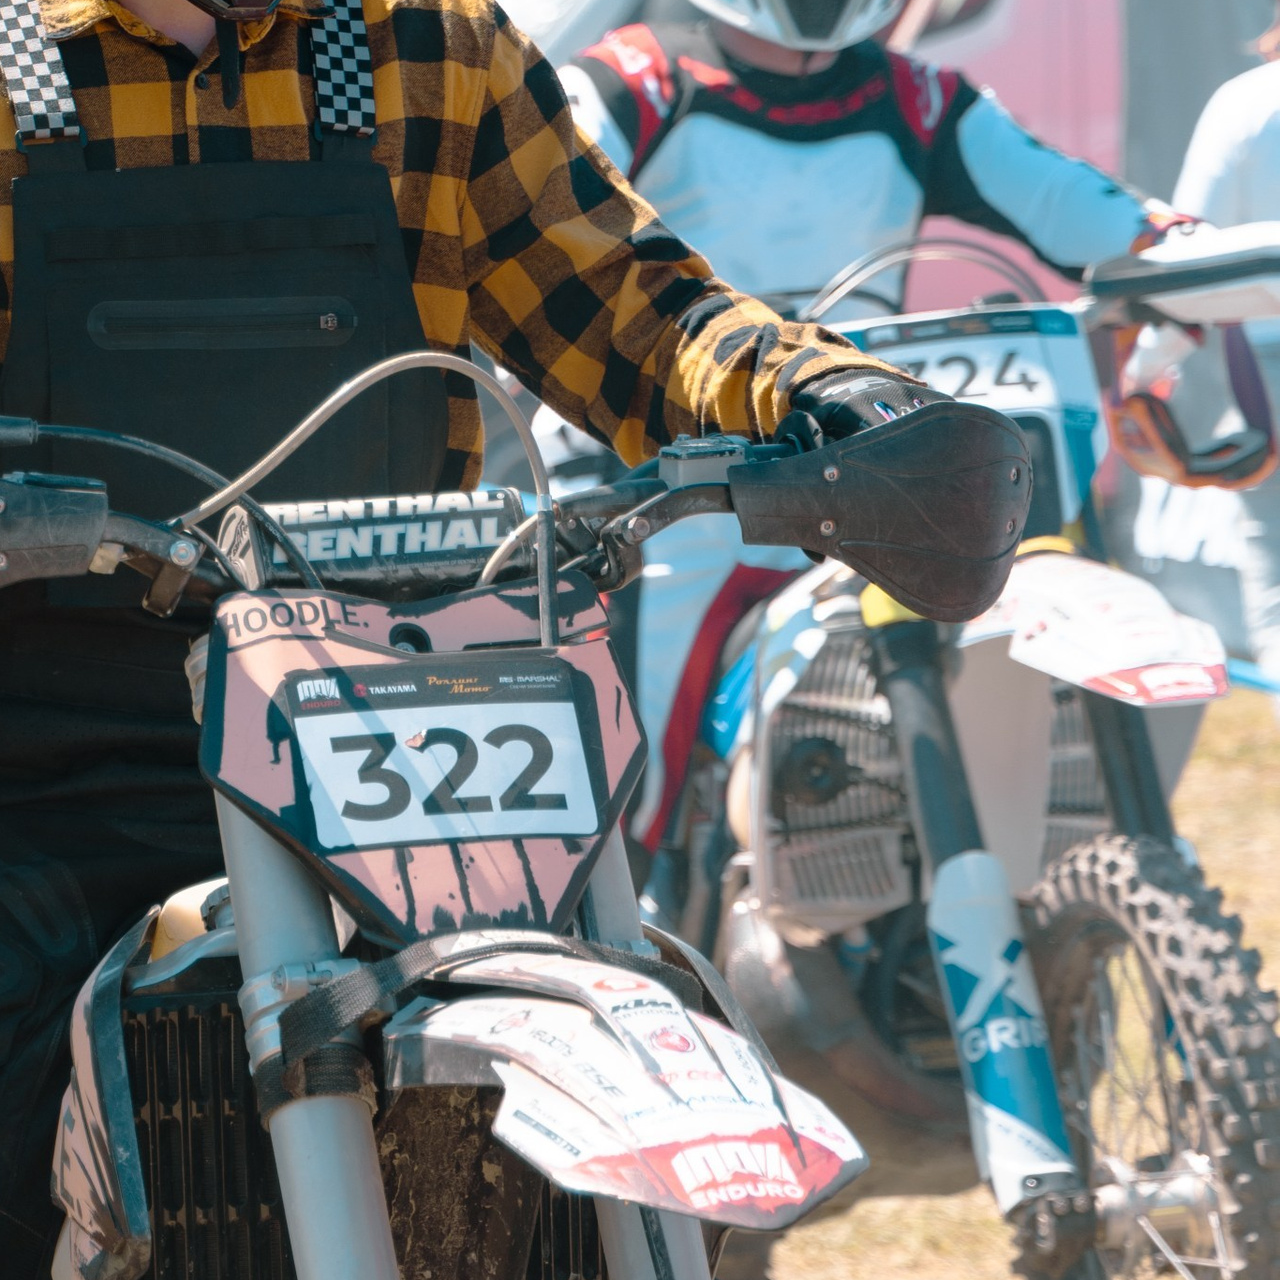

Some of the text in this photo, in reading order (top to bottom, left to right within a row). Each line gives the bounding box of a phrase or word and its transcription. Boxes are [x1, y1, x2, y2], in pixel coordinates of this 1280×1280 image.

[368, 684, 418, 695] TAKAYAMA
[301, 699, 342, 711] ENDURO
[329, 724, 570, 822] 322
[690, 1182, 804, 1209] ENDURO
